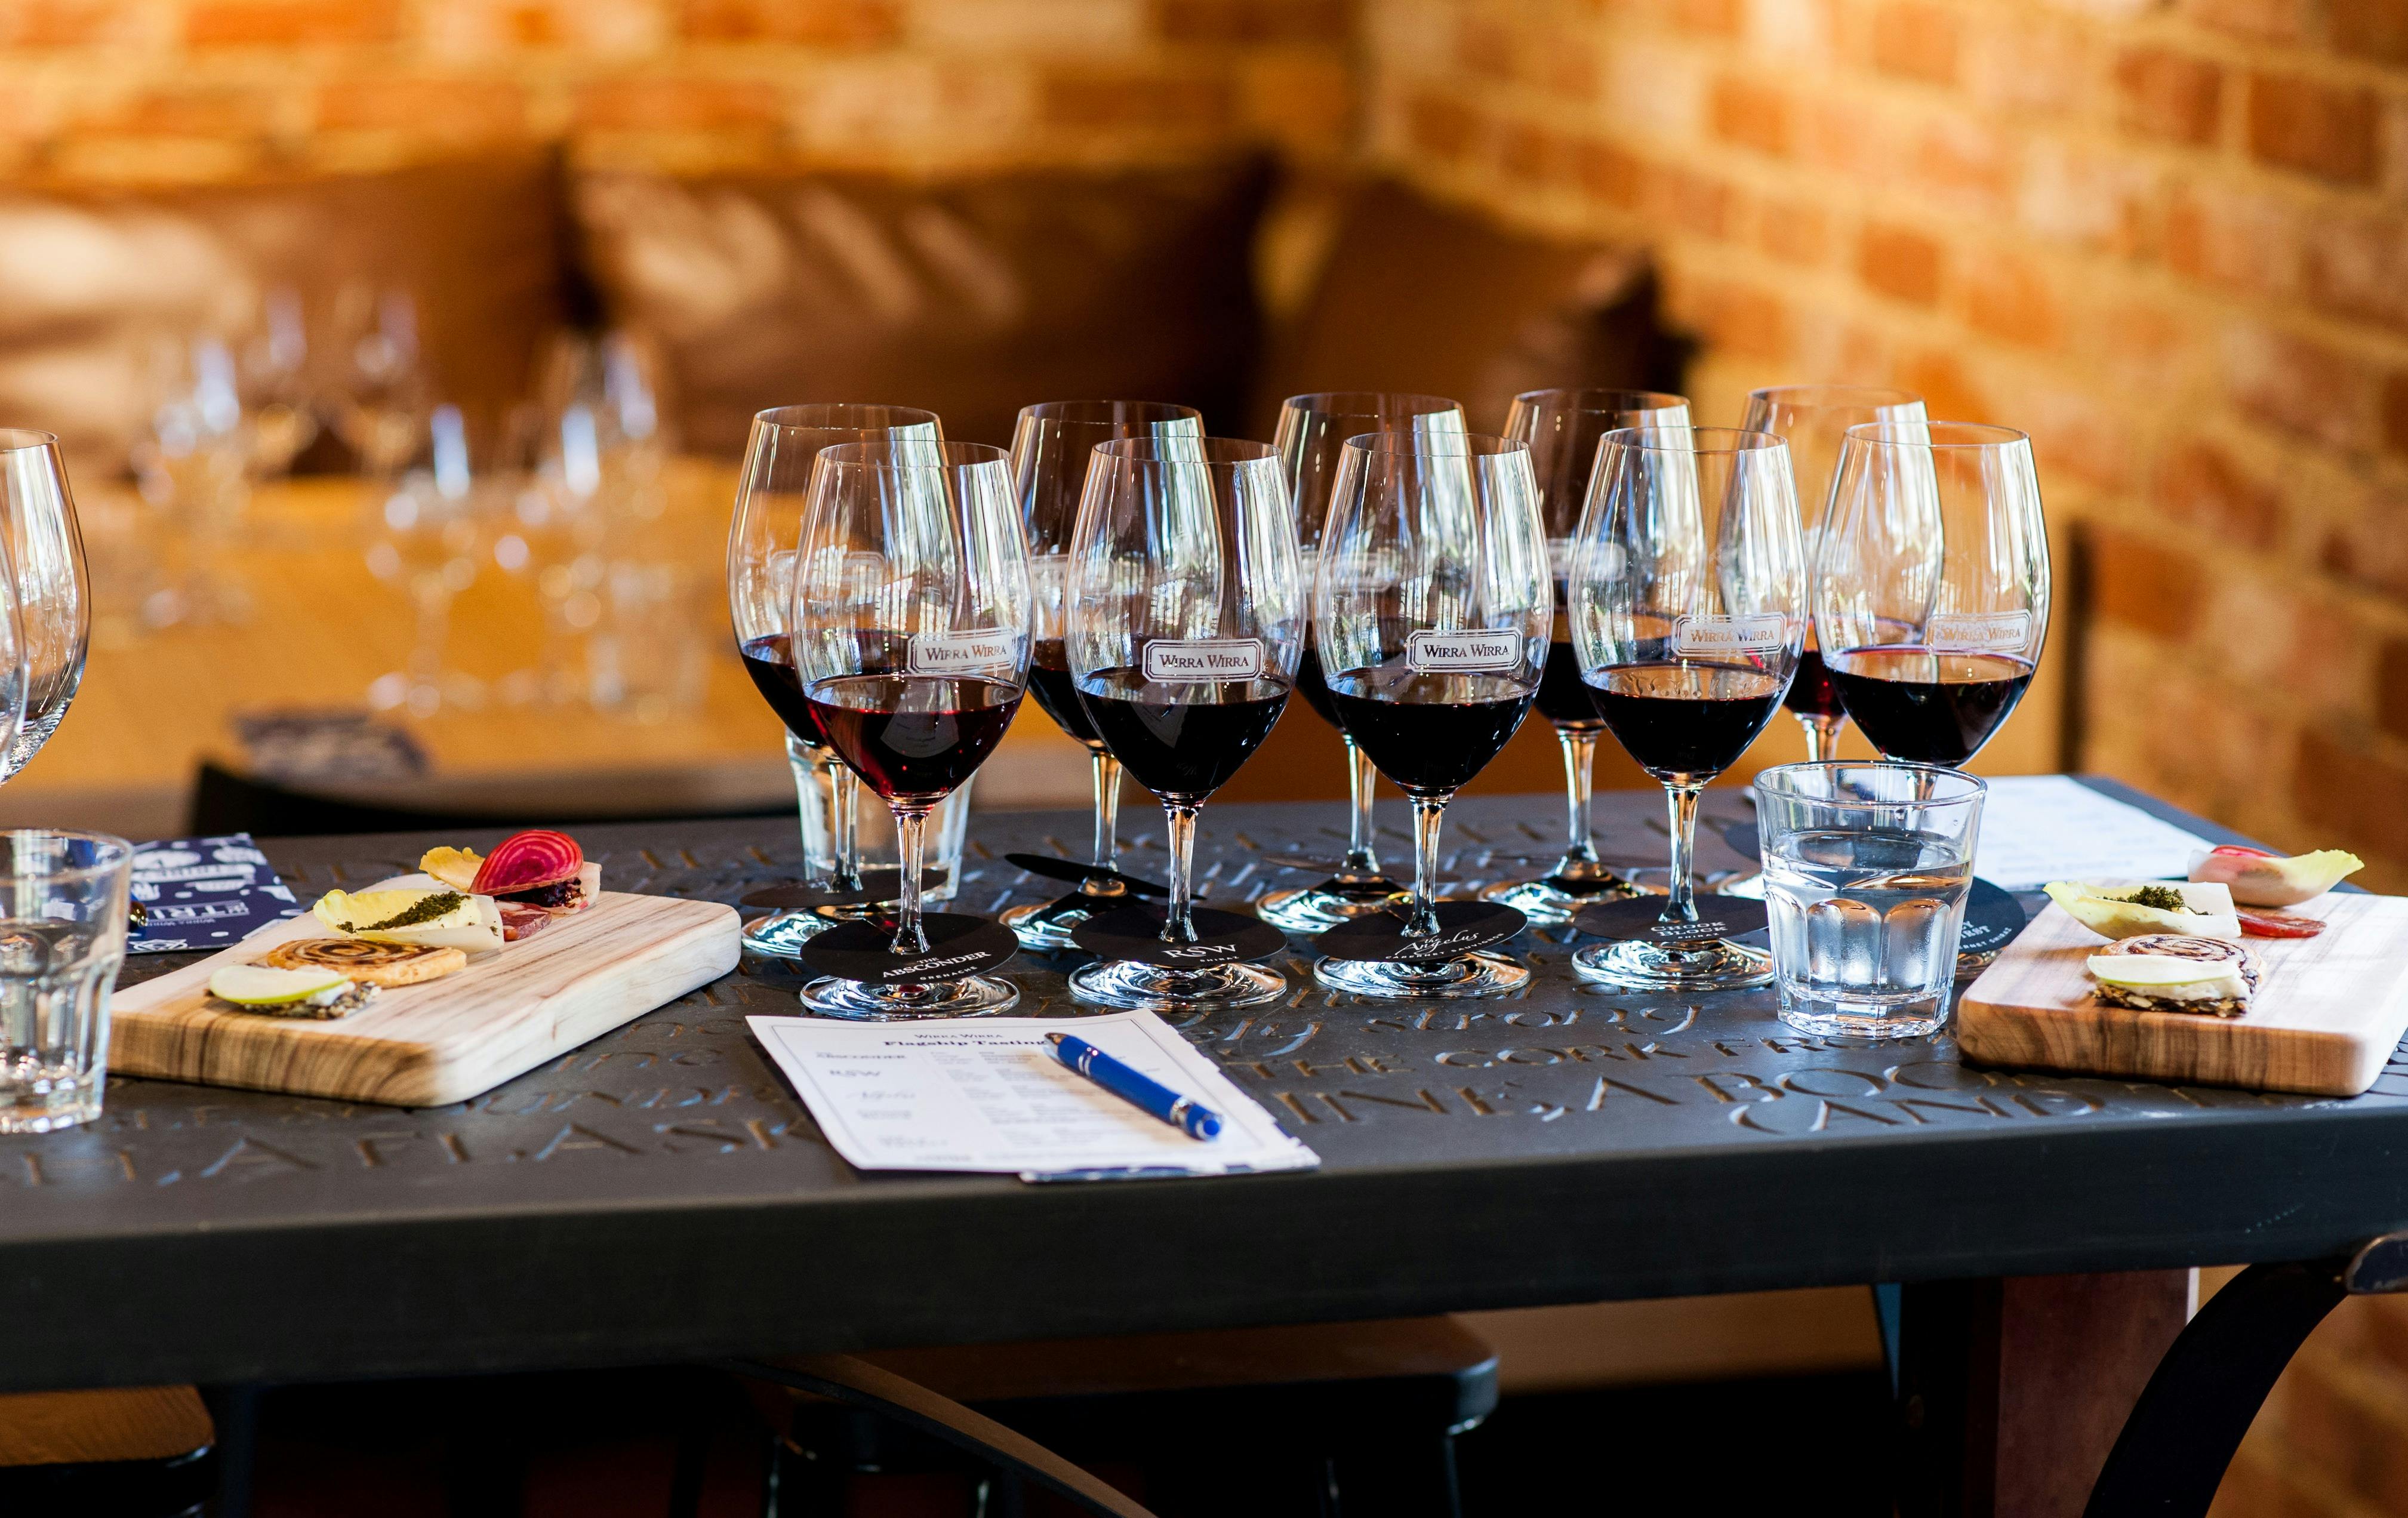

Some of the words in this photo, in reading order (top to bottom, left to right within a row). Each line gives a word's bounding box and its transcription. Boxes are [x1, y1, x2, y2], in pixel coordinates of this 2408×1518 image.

[926, 647, 968, 661] WIRRA
[972, 644, 1006, 657] WIRRA
[1424, 644, 1467, 658] WIRRA
[1470, 643, 1509, 657] WIRRA
[1159, 654, 1205, 668] WIRRA
[1208, 654, 1249, 668] WIRRA
[1651, 921, 1726, 932] CHOOK
[1657, 926, 1728, 937] BLOCK
[1395, 929, 1480, 956] Angelus
[1162, 944, 1237, 958] RSW
[1385, 951, 1445, 960] CABERNET
[883, 951, 992, 978] ABSCONDER
[916, 956, 941, 965] THE
[919, 966, 978, 981] GRENACHE
[1665, 1061, 2030, 1104] BOO
